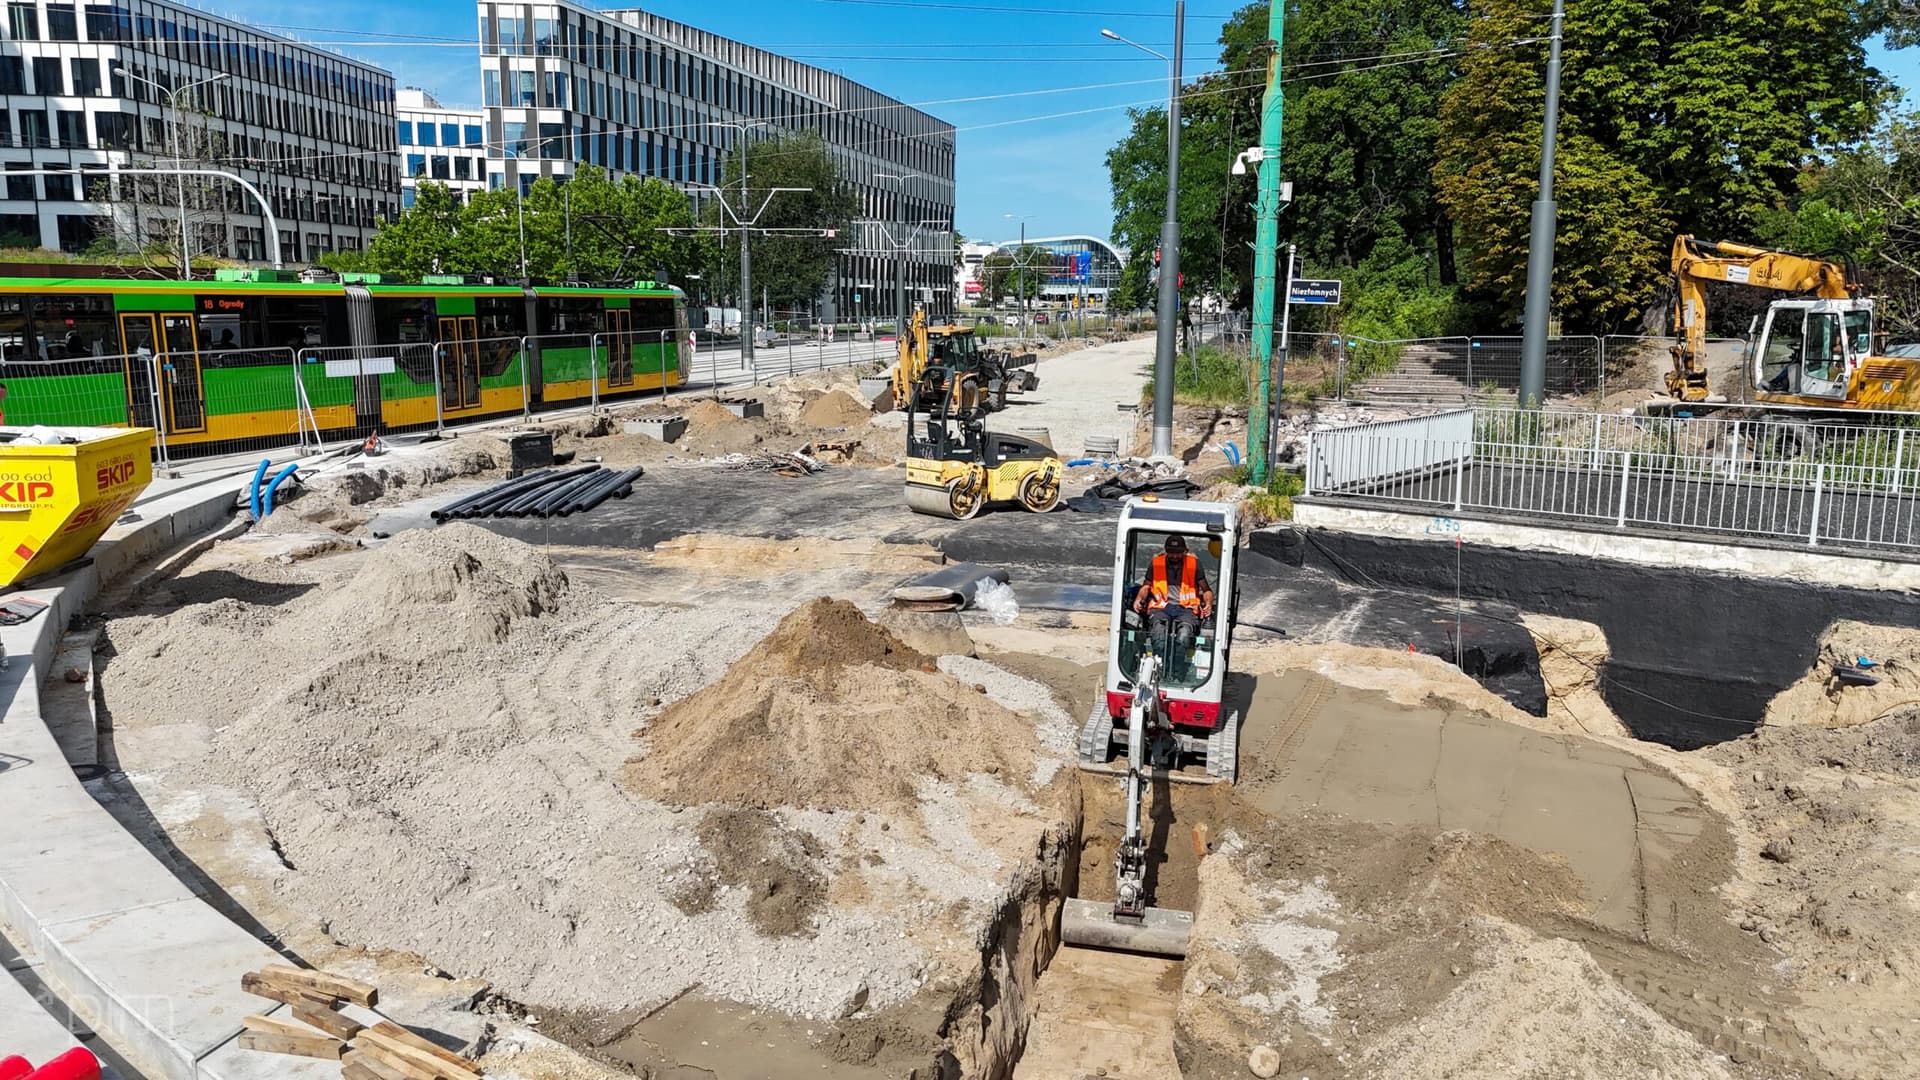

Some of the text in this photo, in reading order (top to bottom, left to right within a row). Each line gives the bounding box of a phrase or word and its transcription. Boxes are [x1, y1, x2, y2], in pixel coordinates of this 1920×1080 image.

[1291, 287, 1338, 298] Niezłomnych
[203, 299, 245, 310] 18 Ogrody
[96, 461, 135, 490] SKIP
